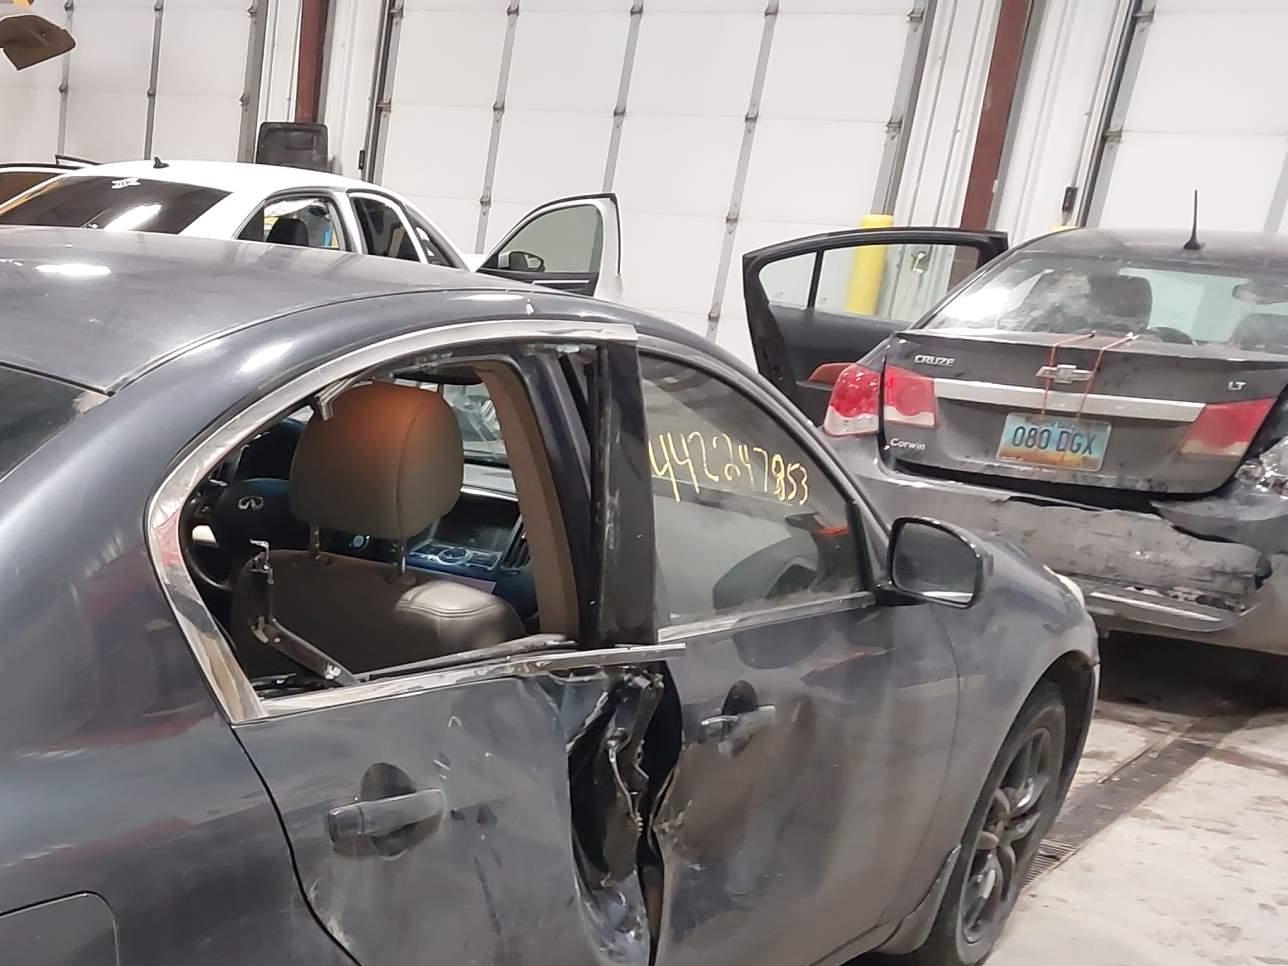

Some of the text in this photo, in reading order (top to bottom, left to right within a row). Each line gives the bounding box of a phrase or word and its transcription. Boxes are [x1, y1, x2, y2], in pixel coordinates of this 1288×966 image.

[914, 354, 955, 367] CRUZE
[1227, 381, 1247, 391] LT
[890, 438, 926, 451] Corwin
[1012, 426, 1096, 455] 080 DGX
